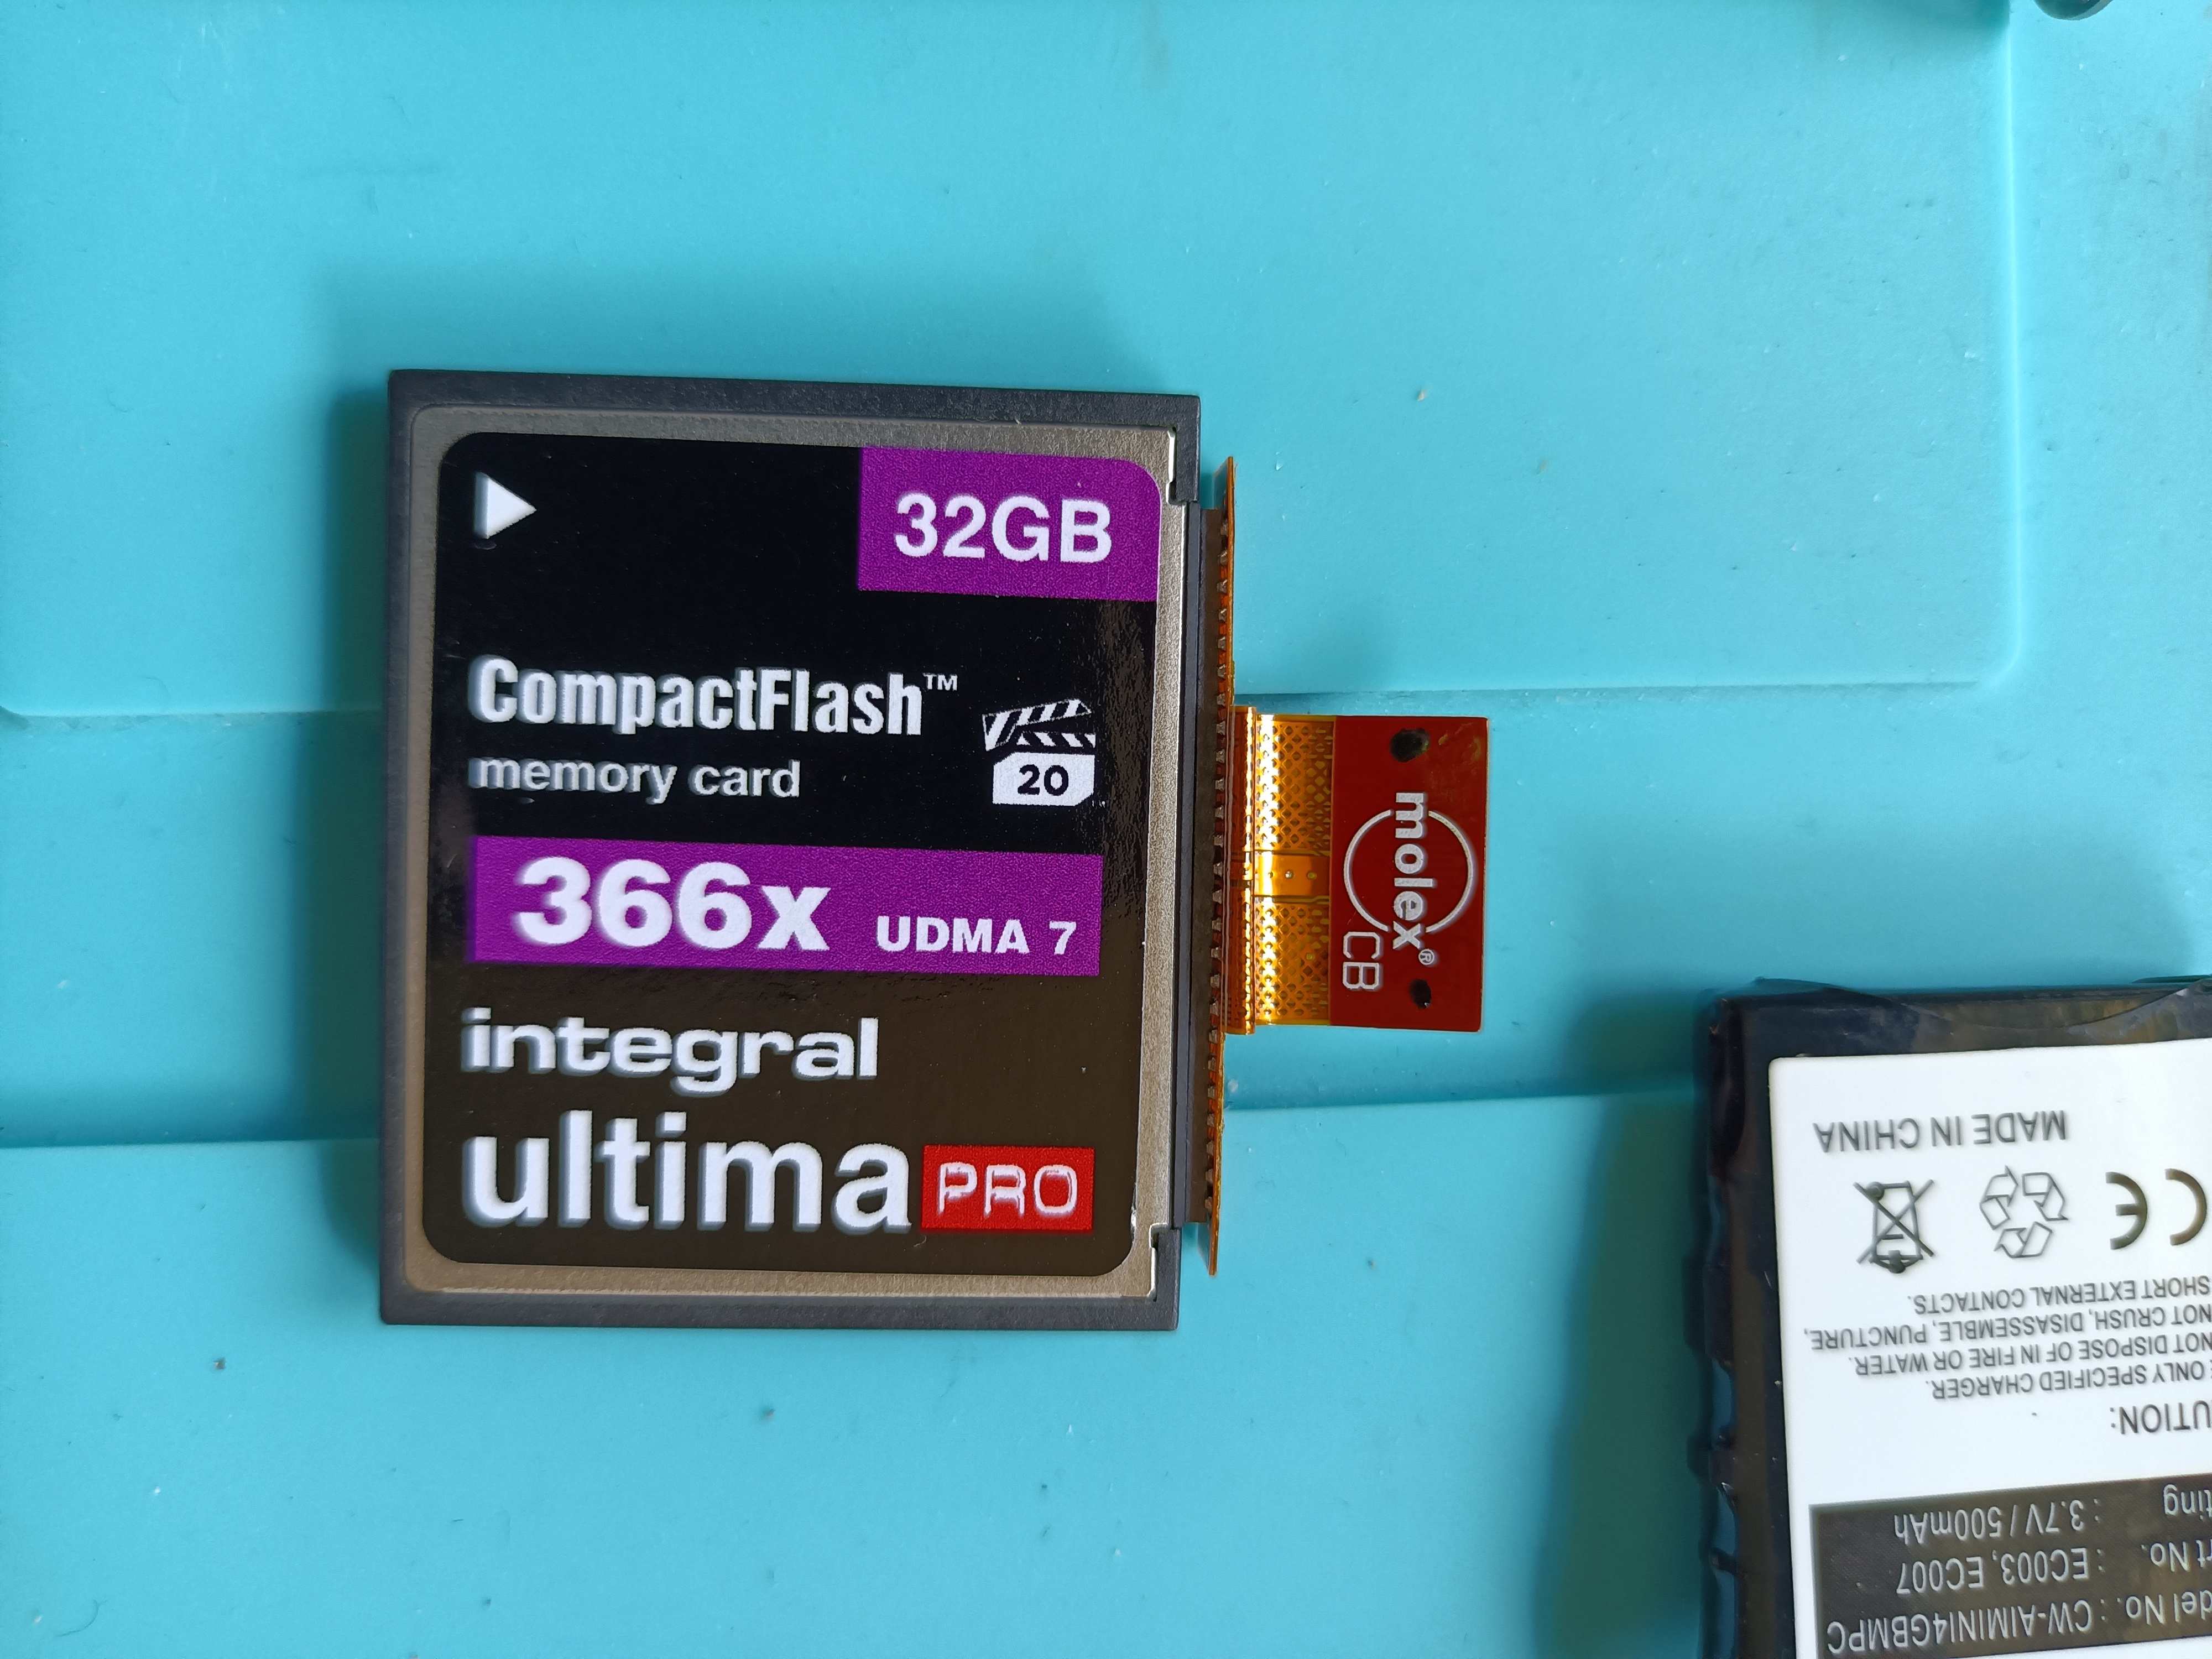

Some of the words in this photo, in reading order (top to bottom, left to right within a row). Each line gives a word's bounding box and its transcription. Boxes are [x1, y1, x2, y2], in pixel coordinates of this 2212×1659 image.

[895, 492, 1113, 563] 32GB
[469, 755, 676, 804] memory
[689, 759, 800, 797] card
[1017, 764, 1070, 797] 20
[513, 856, 830, 951] 366x
[876, 915, 1030, 954] UDMA
[1048, 921, 1077, 956] 7
[1342, 931, 1380, 990] CB
[462, 1007, 879, 1097] integral
[1813, 1118, 1920, 1152] CHINA
[1931, 1116, 1962, 1147] IN
[1971, 1110, 2067, 1144] MADE
[463, 1110, 911, 1234] ultima
[936, 1162, 1078, 1217] PRO
[1907, 1288, 2025, 1314] CONTACTS.
[2030, 1280, 2136, 1307] EXTERNAL
[2143, 1275, 2210, 1298] SHORT
[1932, 1312, 2084, 1342] DISASSEMBLE,
[2088, 1306, 2166, 1328] CRUSH,
[2172, 1303, 2212, 1325] NOT
[1803, 1324, 1927, 1350] PUNCTURE,
[2046, 1341, 2073, 1361] OF
[2077, 1334, 2168, 1359] DISPOSE
[2174, 1332, 2212, 1354] NOT
[1848, 1354, 1929, 1376] WATER.
[1934, 1350, 1963, 1370] OR
[1969, 1346, 2014, 1368] FIRE
[2021, 1344, 2041, 1365] IN
[1925, 1371, 2034, 1399] CHARGER.
[2041, 1364, 2147, 1390] SPECIFIED
[2152, 1360, 2205, 1383] ONLY
[2110, 1400, 2212, 1434] UTION:
[1992, 1547, 2089, 1586] EC003,
[2141, 1542, 2190, 1573] No.
[1896, 1555, 1985, 1595] EC007
[2117, 1595, 2165, 1625] No.
[1826, 1599, 2093, 1656] CW-AIMINI4GBMPC
